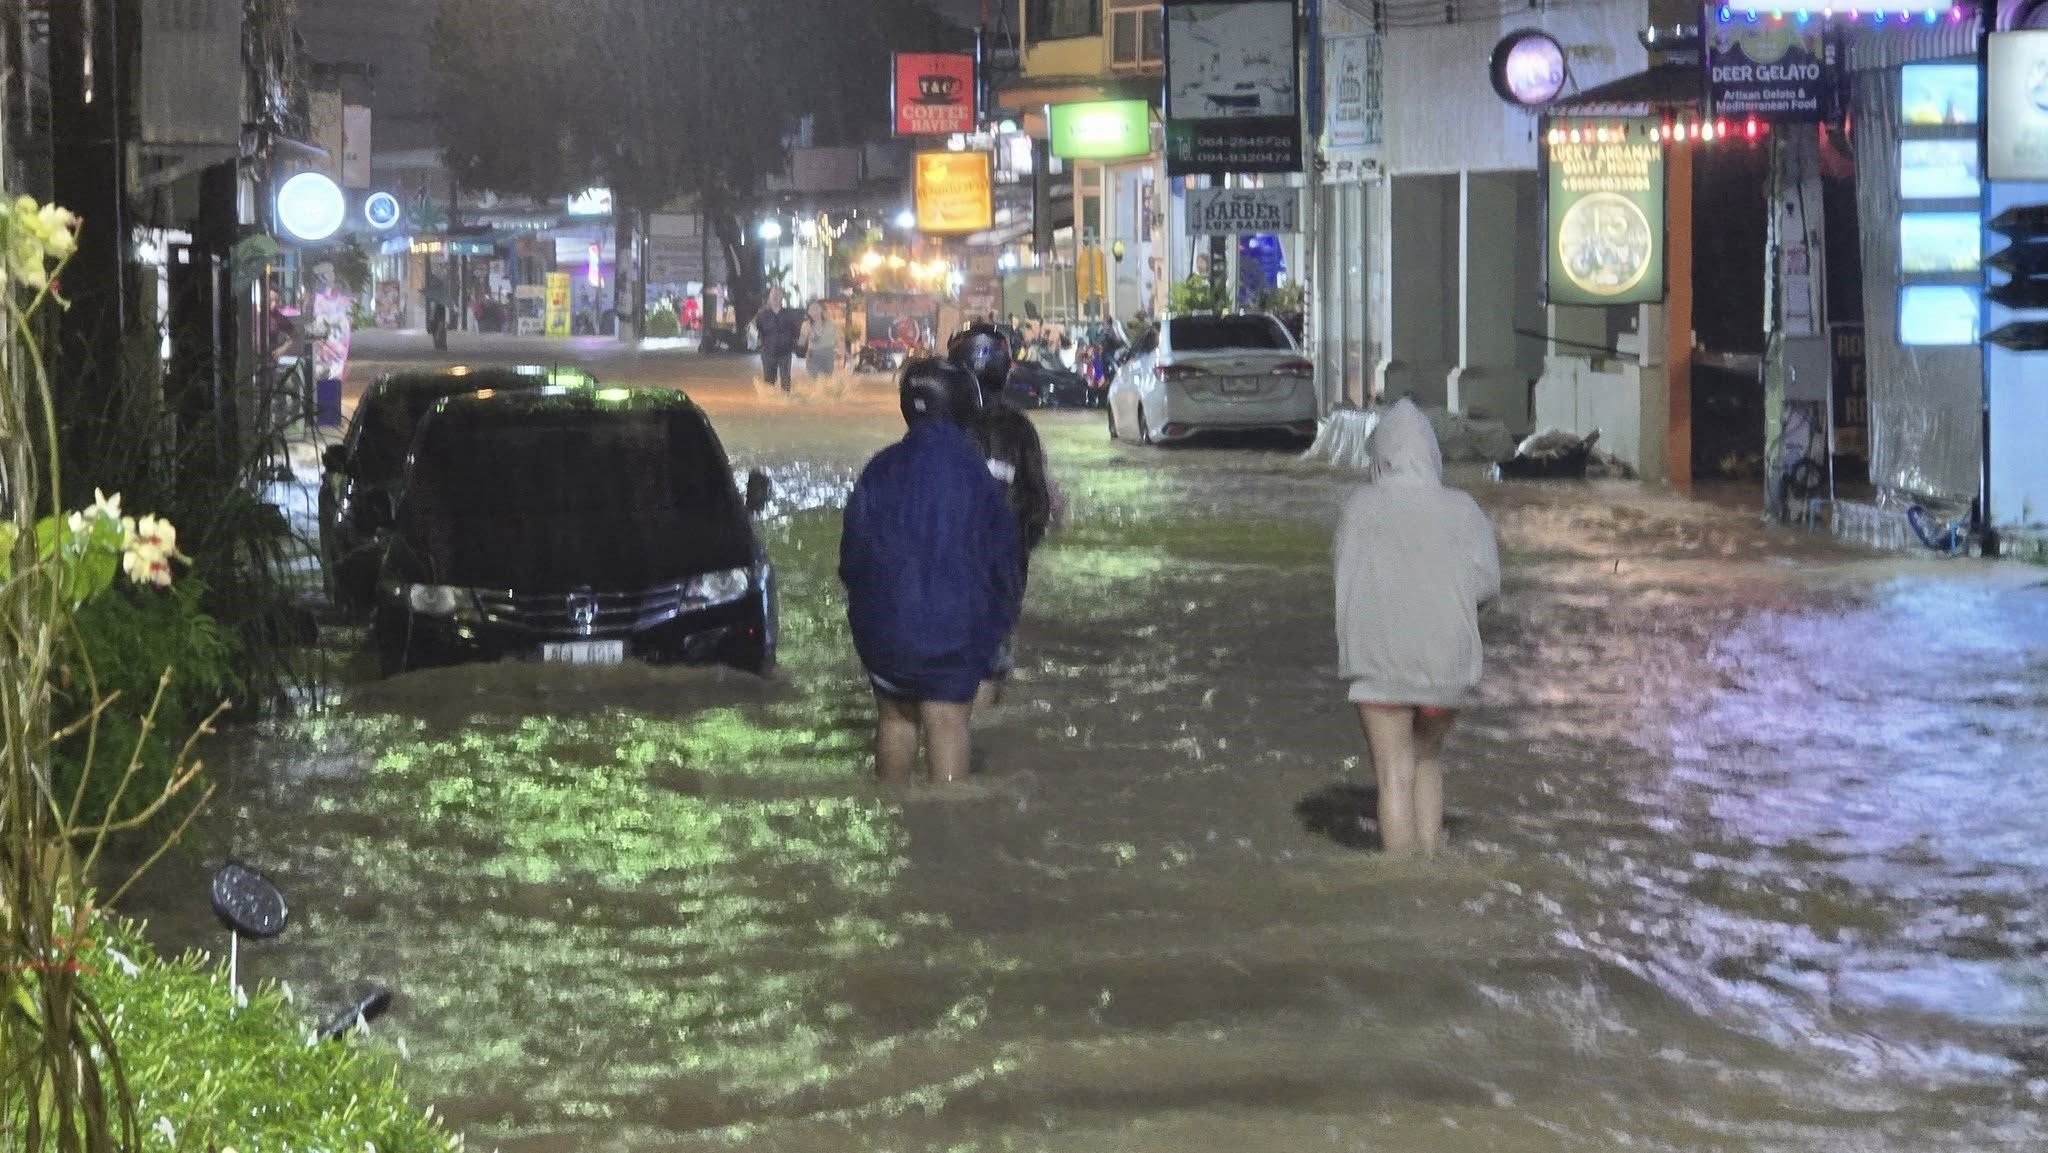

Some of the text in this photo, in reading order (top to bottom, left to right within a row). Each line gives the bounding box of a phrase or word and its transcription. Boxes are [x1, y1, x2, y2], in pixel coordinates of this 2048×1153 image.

[1712, 63, 1820, 83] DEER GELATO
[1723, 89, 1761, 101] Artisan
[902, 104, 968, 120] COFFEE
[1716, 96, 1817, 113] Mediterranean Food
[911, 119, 959, 132] HAVEN
[1550, 144, 1661, 162] LUCKY ANDAMAN
[1205, 201, 1281, 219] BARBER
[1205, 221, 1233, 230] LUX
